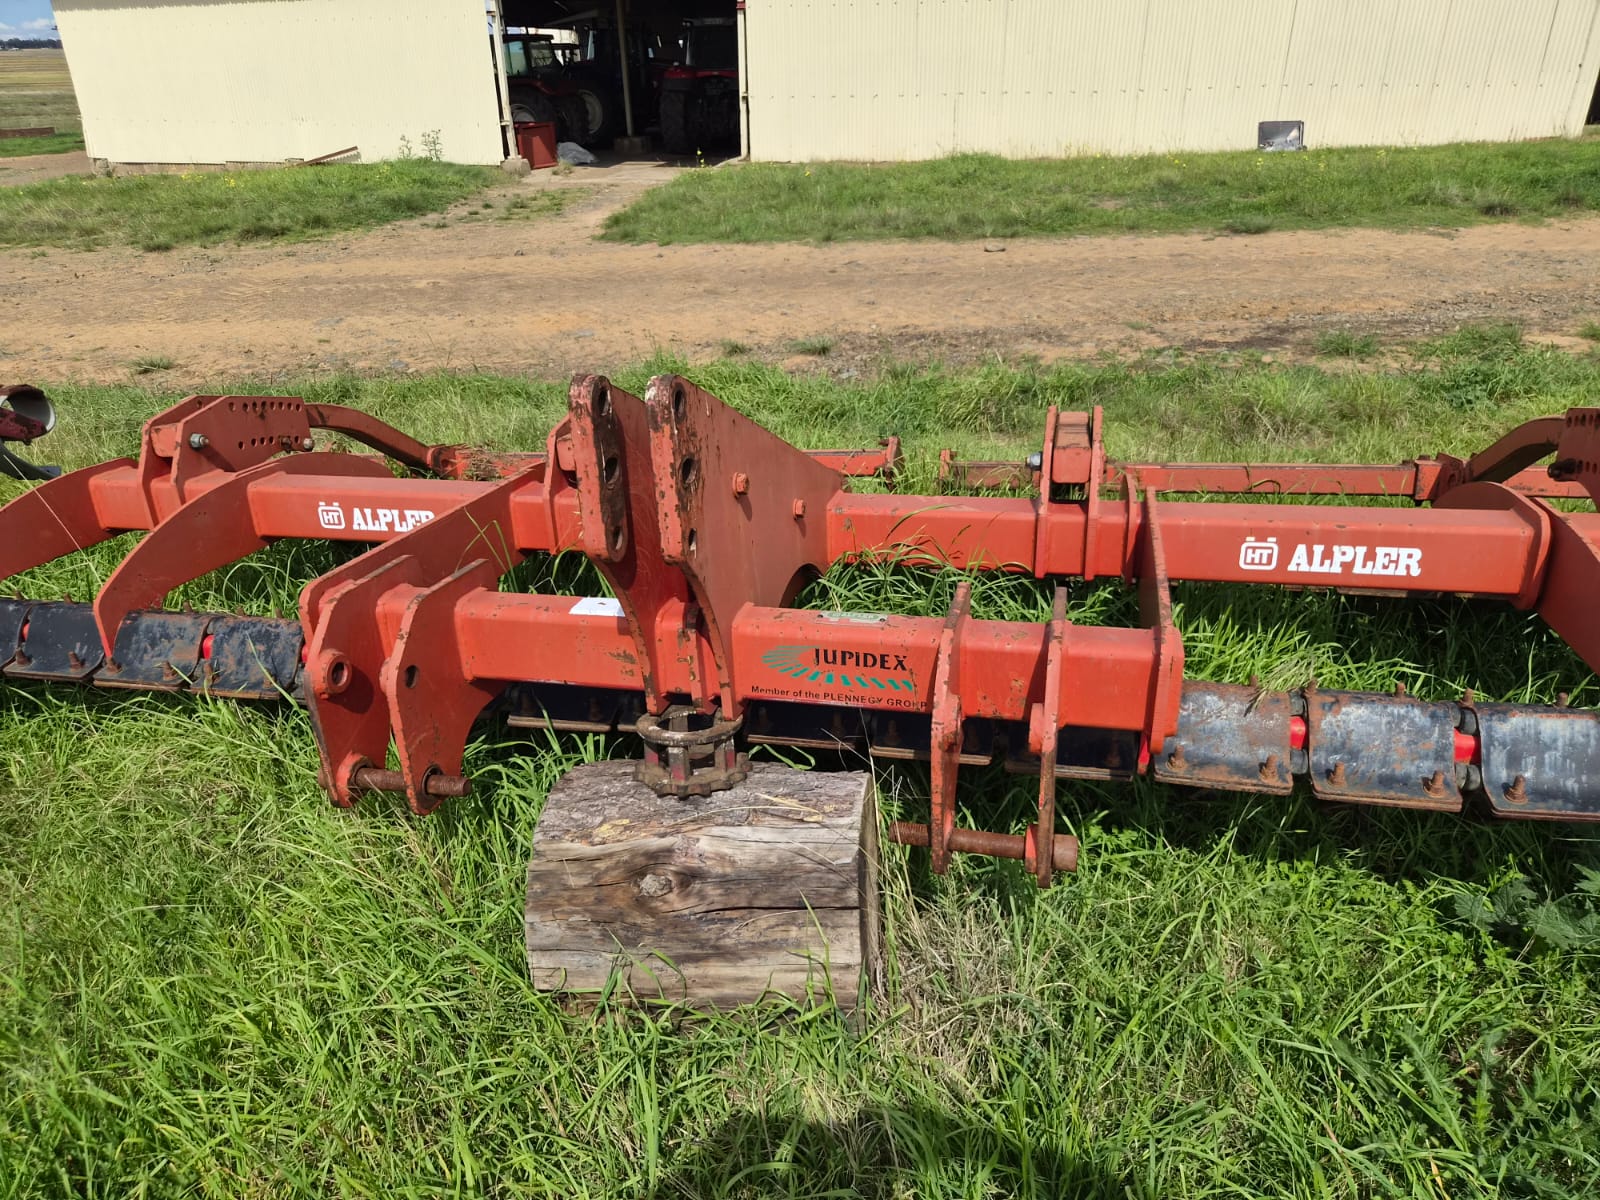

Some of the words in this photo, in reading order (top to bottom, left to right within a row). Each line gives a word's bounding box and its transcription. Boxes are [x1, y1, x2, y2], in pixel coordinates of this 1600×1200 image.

[1287, 543, 1423, 577] ALPLER
[814, 648, 907, 671] JUPIDEX
[751, 685, 789, 696] Member
[792, 689, 803, 698] of
[804, 690, 821, 700] the
[823, 692, 883, 705] PLENNEGY
